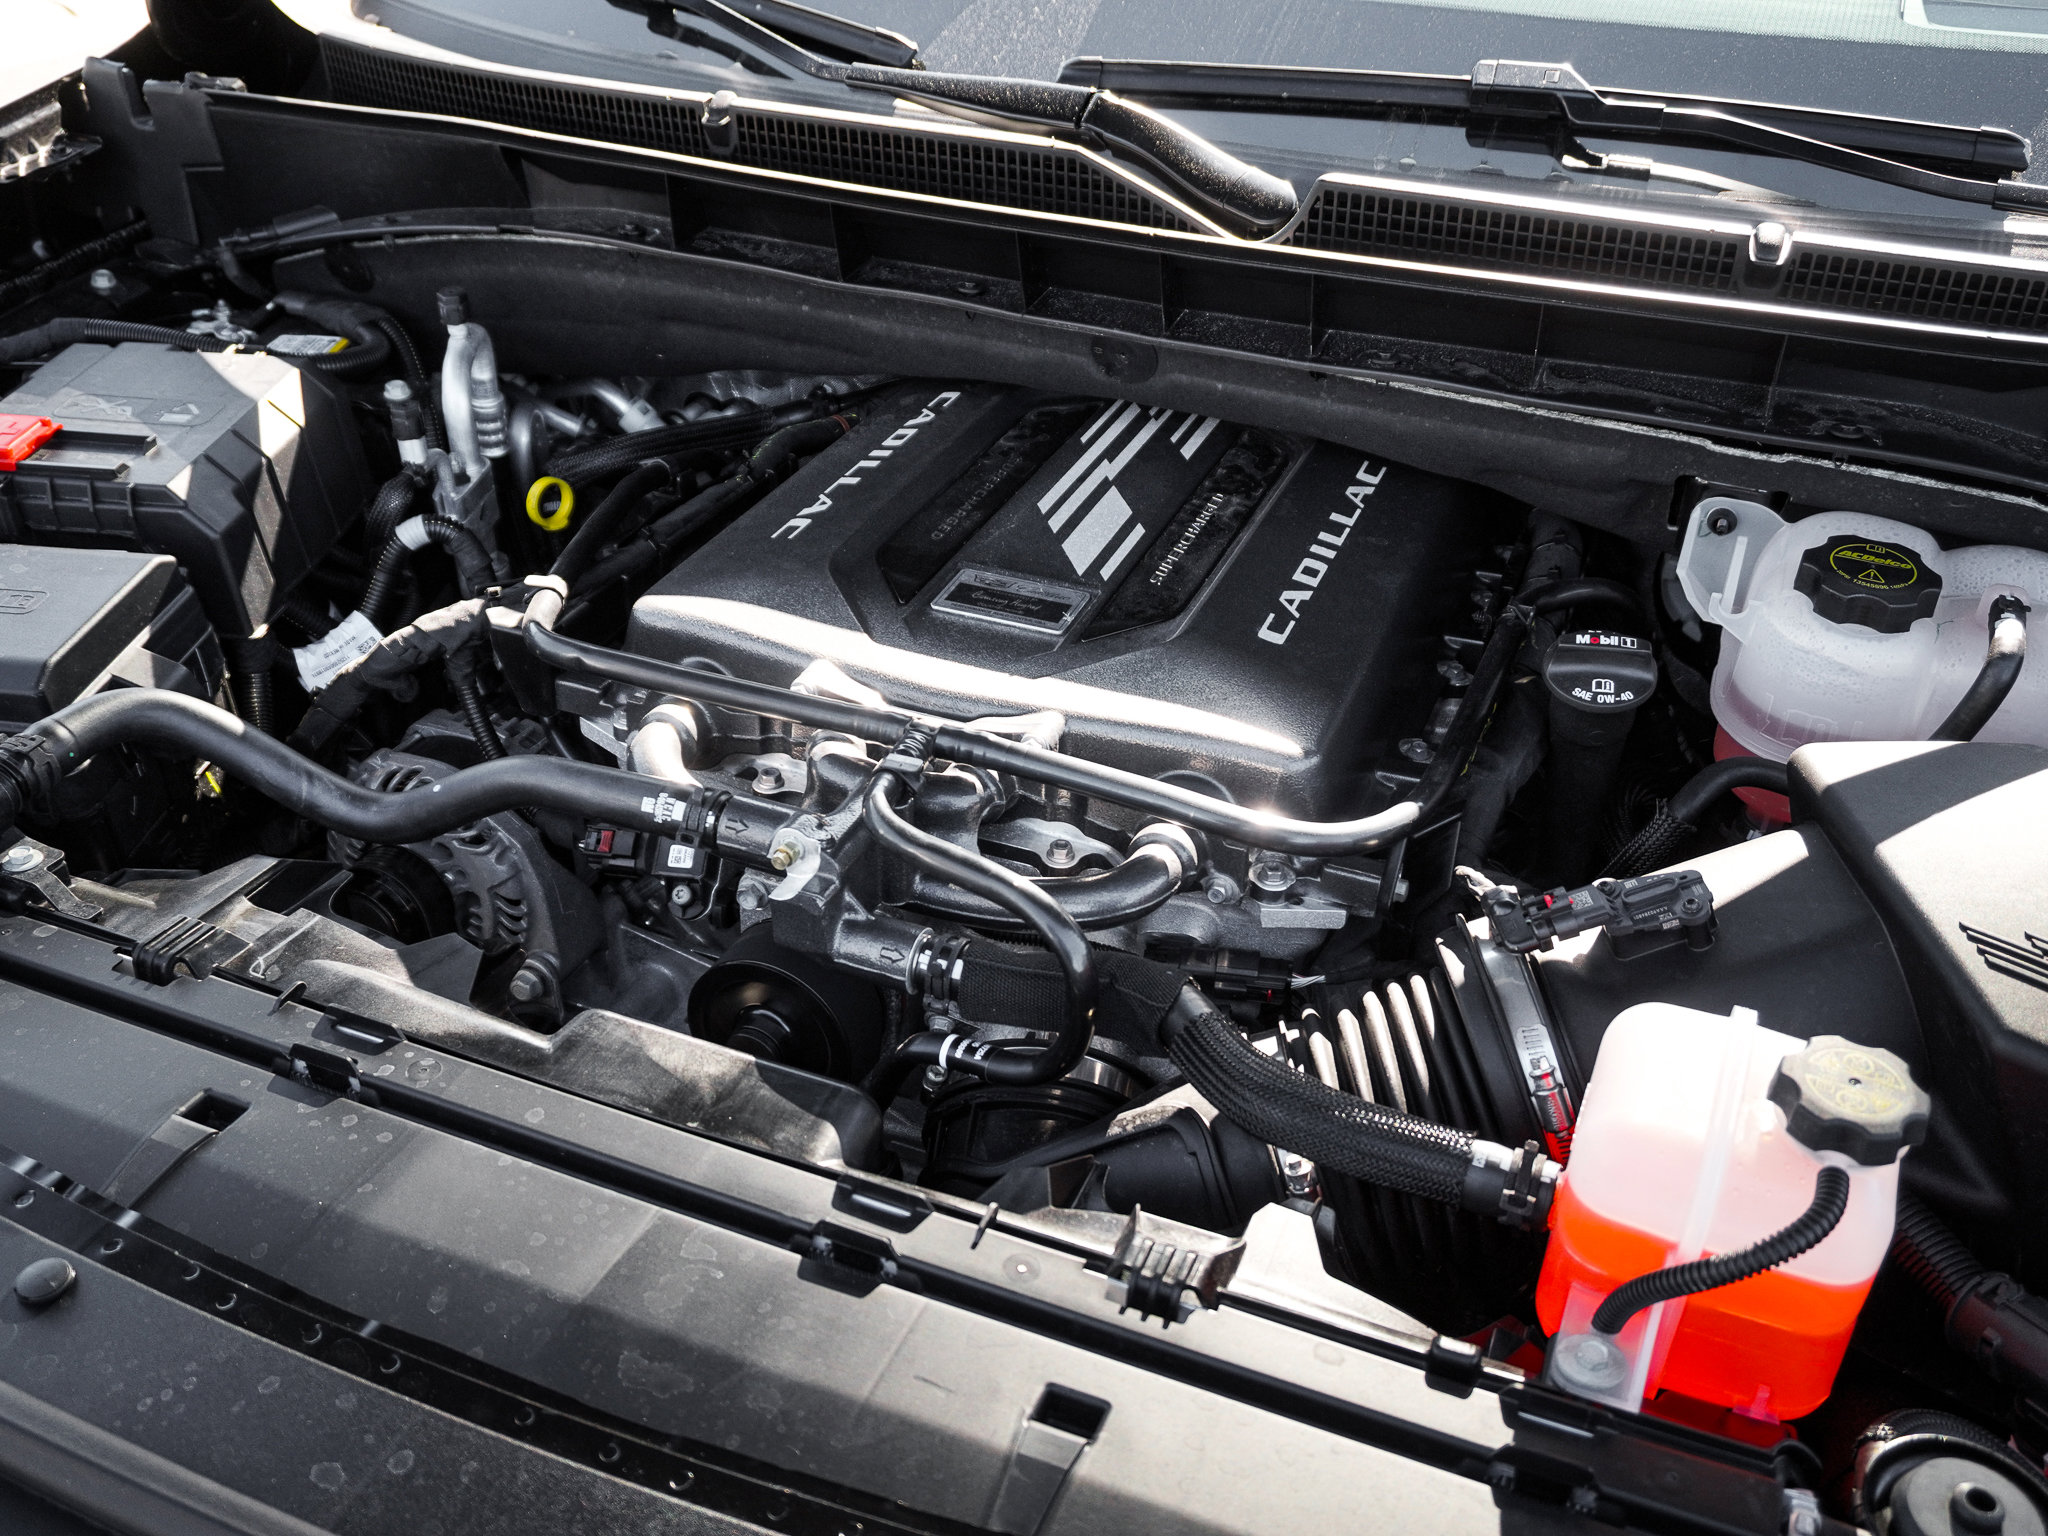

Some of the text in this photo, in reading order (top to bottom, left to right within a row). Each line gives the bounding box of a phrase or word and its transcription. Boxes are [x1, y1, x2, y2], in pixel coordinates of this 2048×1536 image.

[771, 391, 961, 539] CADILLAC
[1149, 493, 1224, 586] SUPERCHARGED
[1257, 460, 1387, 645] CADILLAC
[1838, 550, 1912, 568] ACDelco
[1575, 634, 1619, 646] Mobil
[1571, 687, 1635, 704] SAE 0W-40
